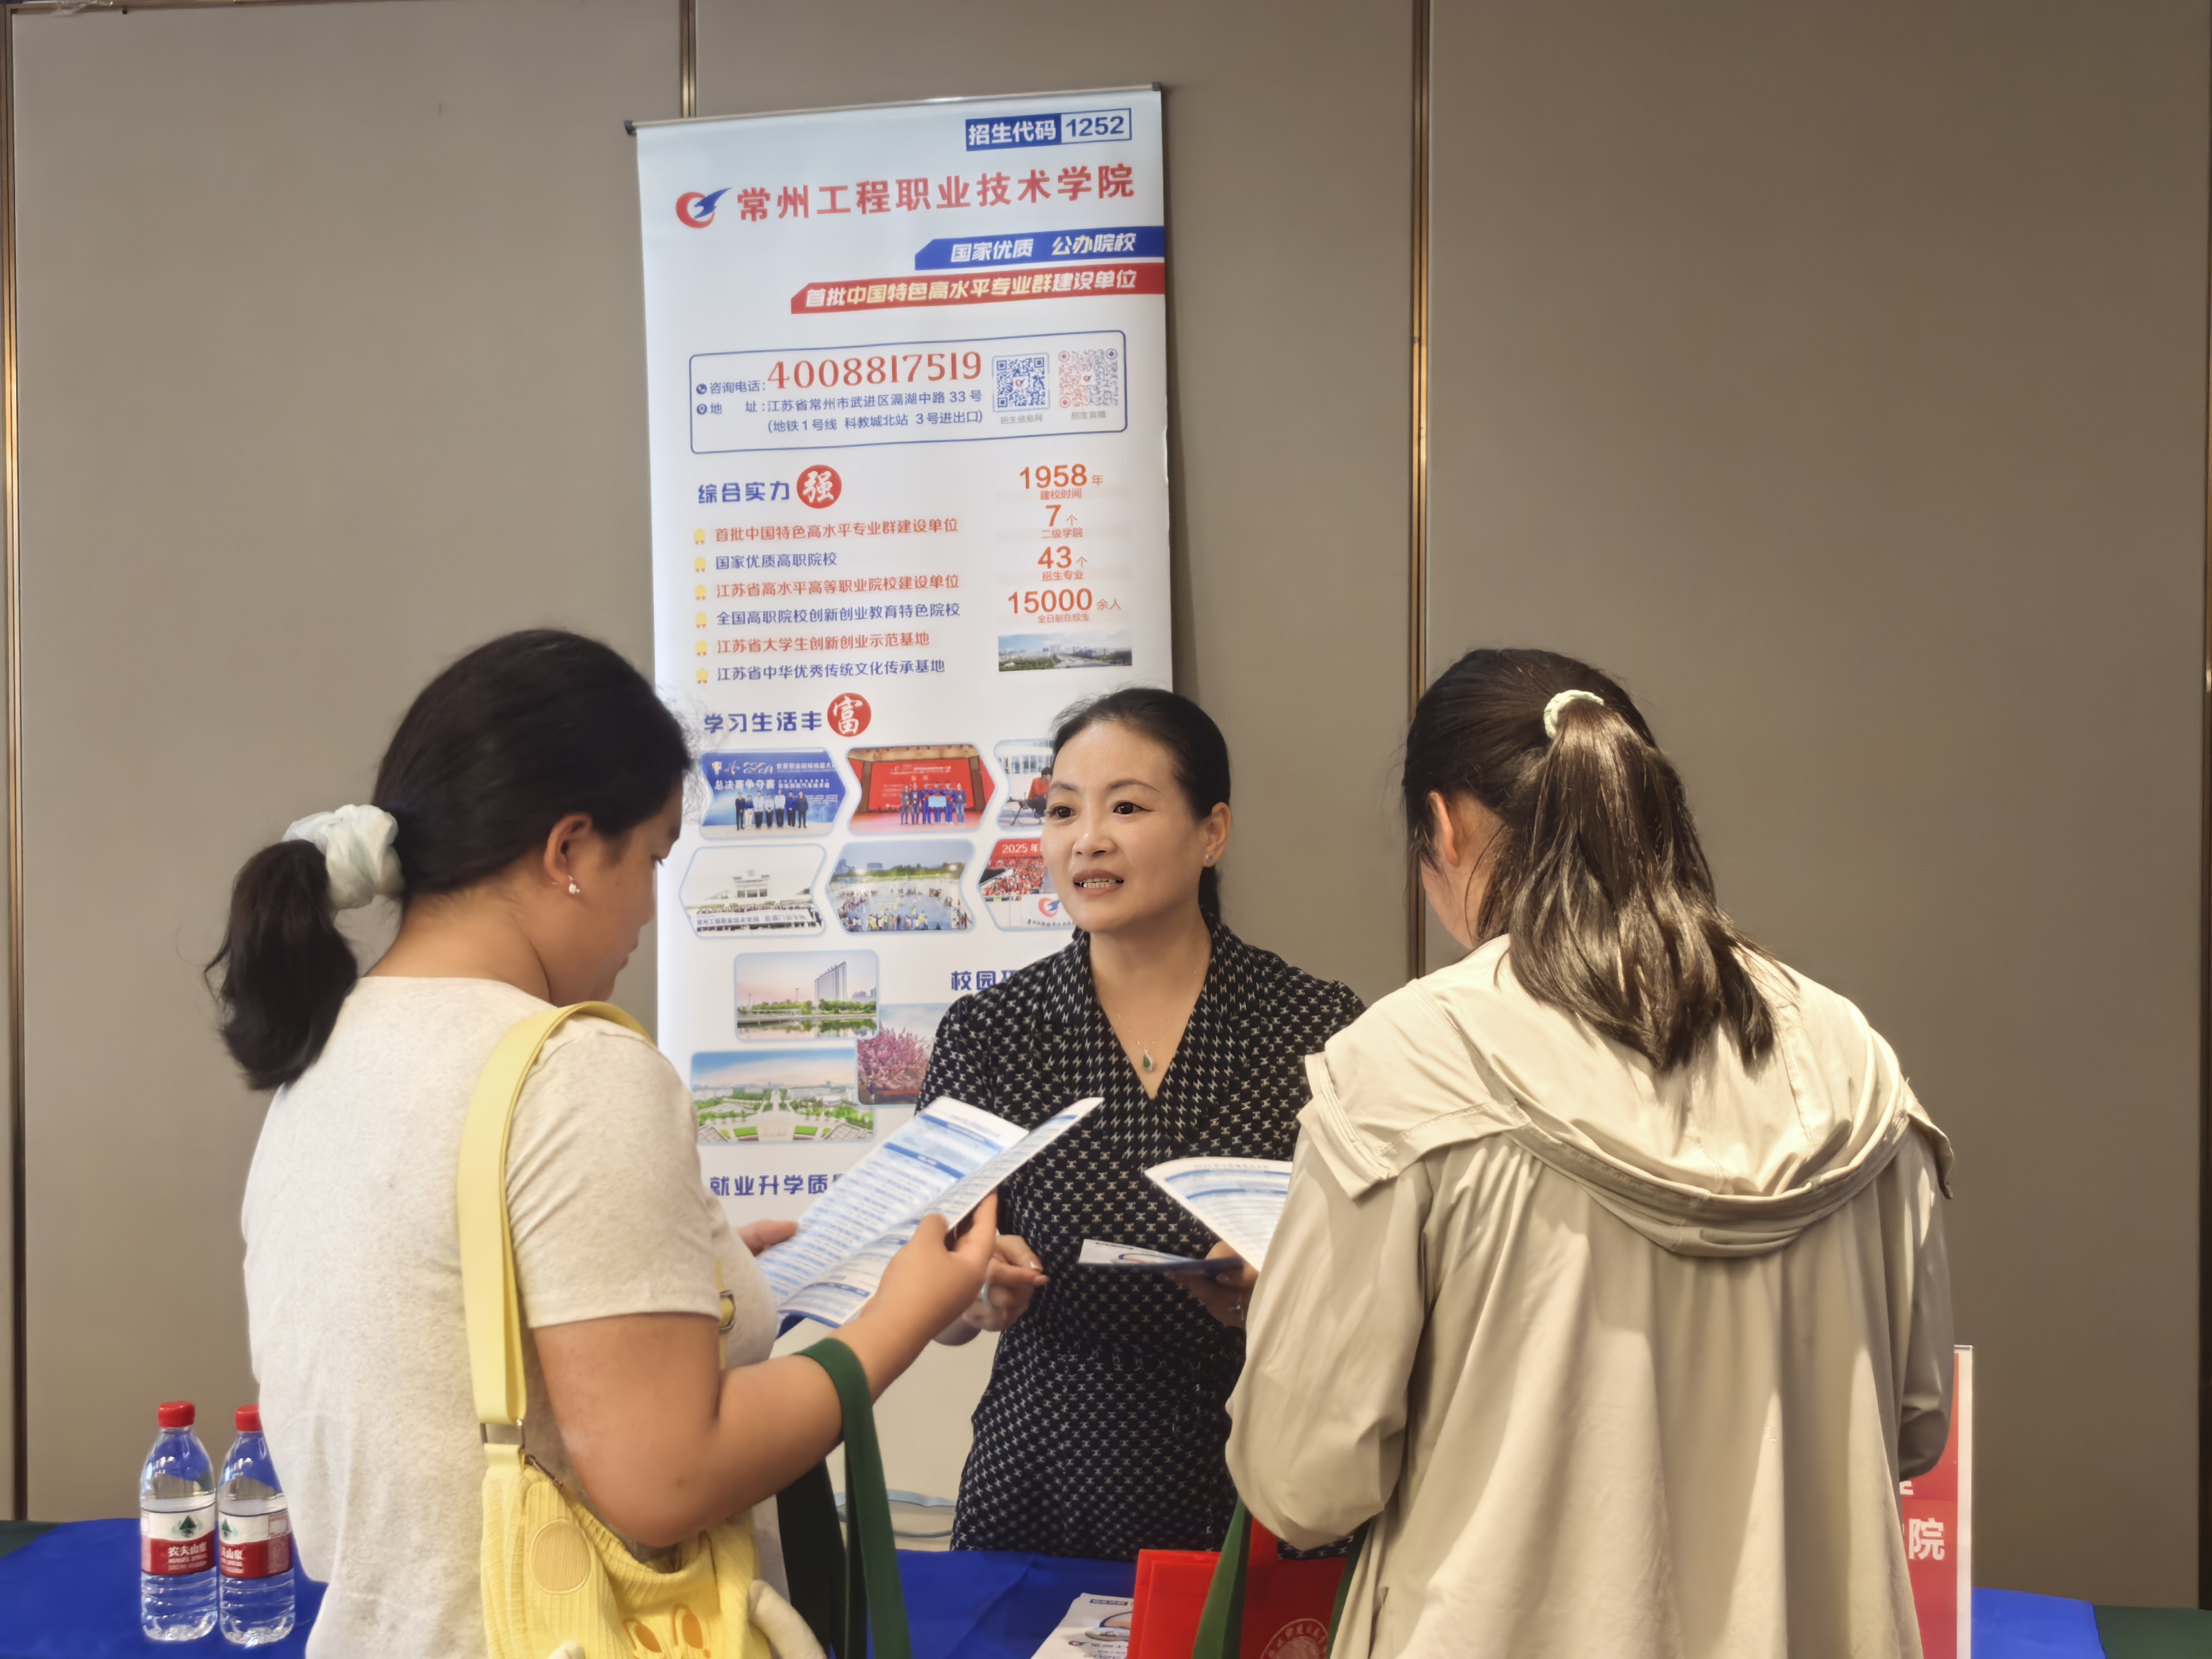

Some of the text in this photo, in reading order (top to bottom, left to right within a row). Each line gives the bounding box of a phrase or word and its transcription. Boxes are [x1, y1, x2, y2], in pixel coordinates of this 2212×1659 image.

[967, 115, 1125, 146] 招生代码 1252
[737, 163, 1135, 222] 常州工程职业技术学院
[950, 231, 1137, 263] 国家优质 公办院校
[805, 269, 1137, 308] 首批中国特色高水平专业群建设单位
[767, 351, 981, 389] 4008817519
[698, 470, 834, 504] 综合实力 强
[1020, 463, 1088, 489] 1958
[1046, 504, 1062, 527] 7
[715, 517, 959, 542] 首批中国特色高水平专业群建设单位
[1041, 527, 1083, 539] 二级学院
[716, 552, 837, 570] 国家优质高职院校
[1037, 545, 1072, 569] 43
[716, 574, 960, 598] 江苏省高水平高等职业院校建设单位
[1042, 569, 1084, 582] 招生专业
[1008, 588, 1122, 614] 15000 余人
[717, 602, 960, 625] 全国高职院校创新创业教育特色院校
[717, 631, 930, 654] 江苏省大学生创新创业示范基地
[717, 659, 945, 681] 江苏省中华优秀传统文化传承基地
[704, 696, 863, 734] 学习生活丰 富
[710, 1173, 844, 1196] 就业升学质
